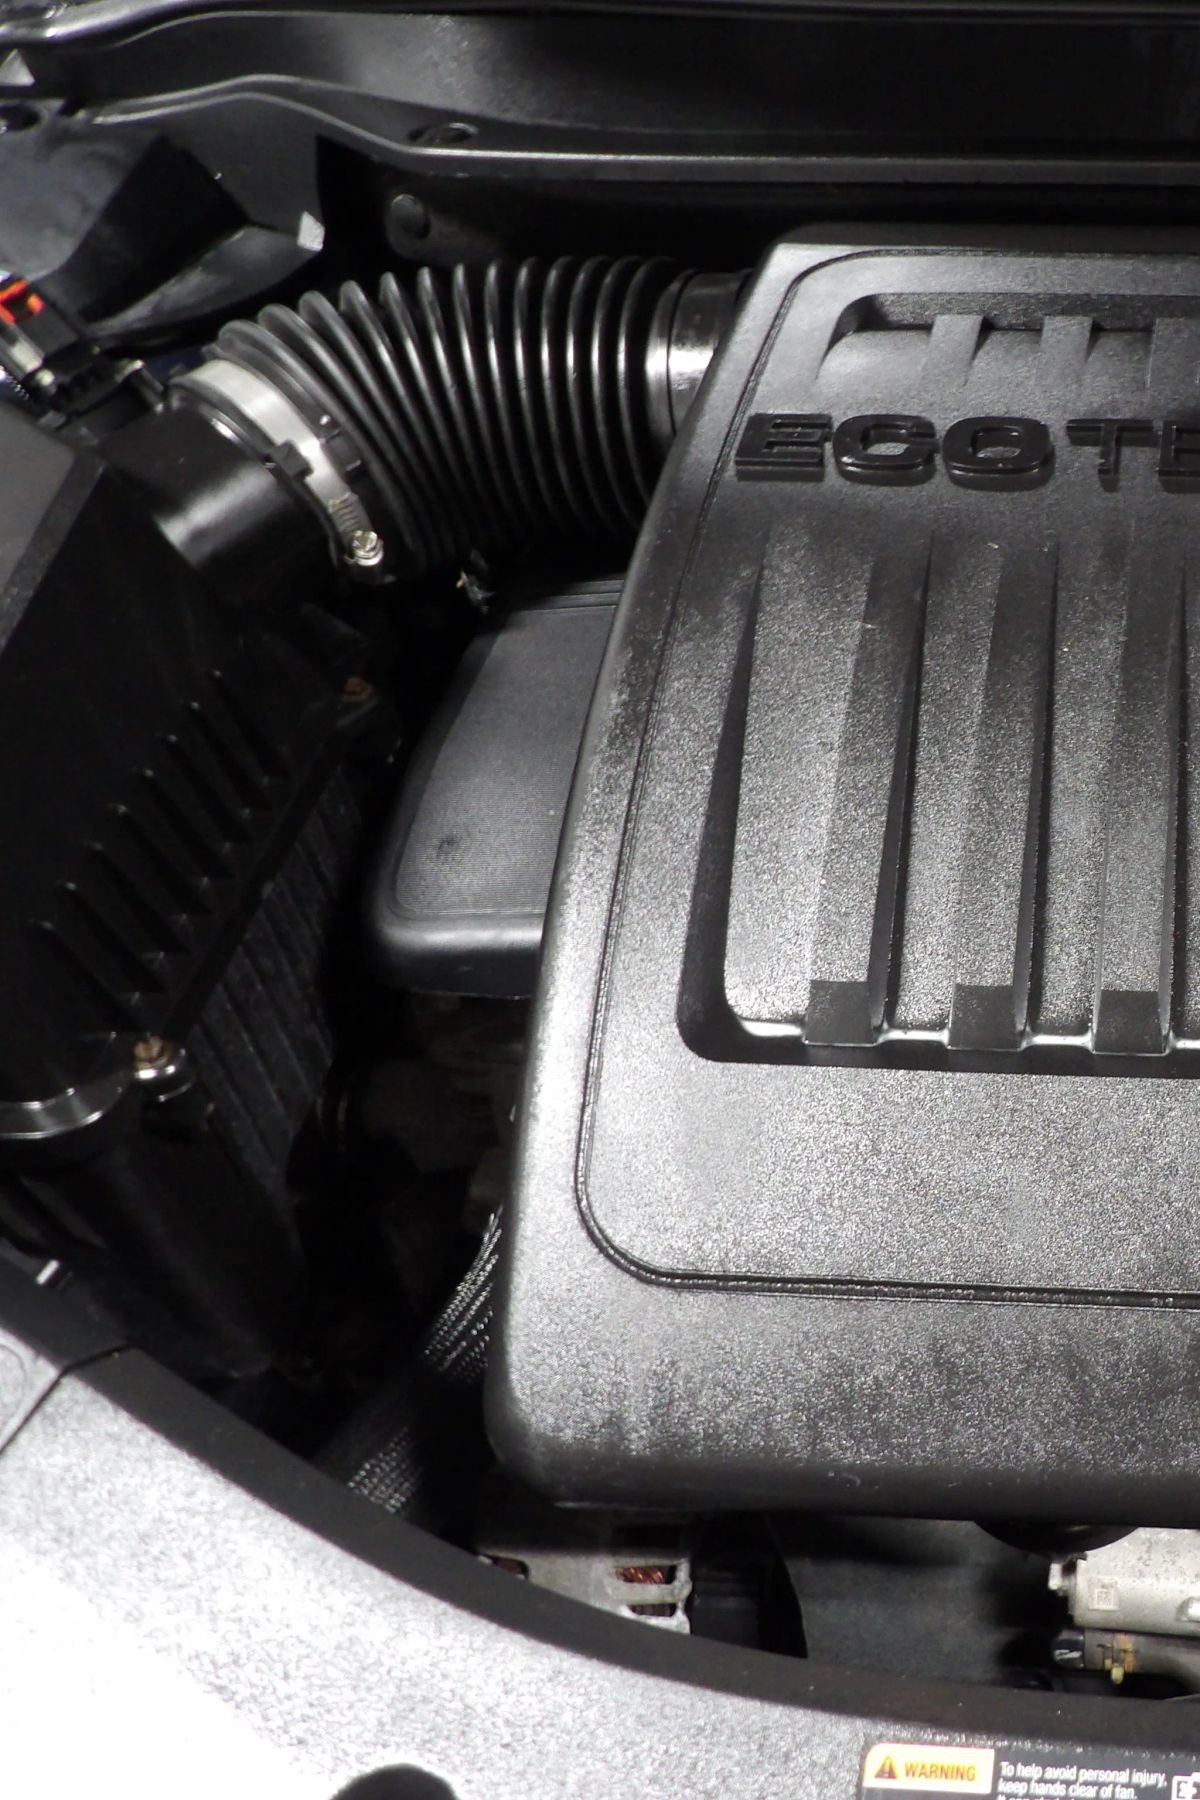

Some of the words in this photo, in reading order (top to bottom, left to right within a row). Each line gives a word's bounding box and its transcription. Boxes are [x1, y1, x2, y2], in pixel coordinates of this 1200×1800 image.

[904, 1761, 976, 1782] WARNING
[1000, 1761, 1015, 1777] To
[1016, 1762, 1043, 1781] help
[1043, 1765, 1077, 1780] avoid
[1078, 1768, 1130, 1784] personal
[1131, 1768, 1167, 1790] injury,
[997, 1778, 1028, 1797] keep
[1029, 1779, 1067, 1797] hands
[1067, 1781, 1098, 1798] clear
[1100, 1783, 1114, 1799] of
[1114, 1784, 1138, 1800] fan.
